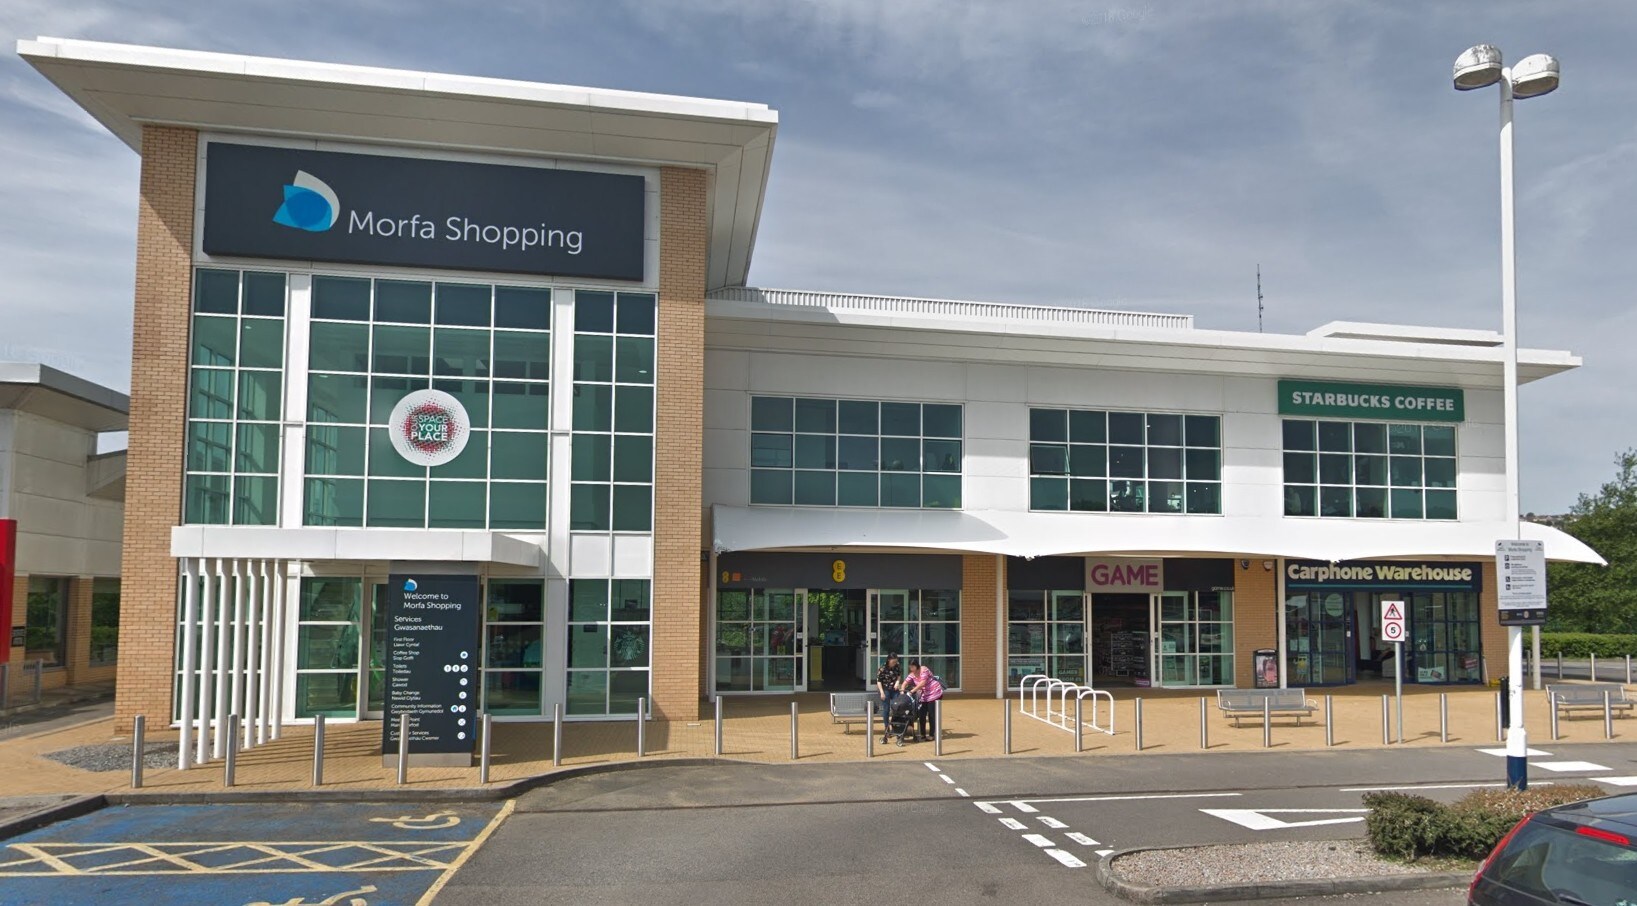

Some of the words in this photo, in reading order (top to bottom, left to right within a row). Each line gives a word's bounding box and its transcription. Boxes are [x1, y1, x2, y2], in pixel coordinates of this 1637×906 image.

[348, 209, 435, 239] Morfa
[445, 216, 583, 255] Shopping
[1292, 391, 1390, 408] STARBUCKS
[1394, 396, 1454, 411] COFFEE
[418, 414, 448, 423] SPACE
[419, 423, 448, 432] YOUR
[411, 431, 448, 441] PLACE
[1091, 564, 1159, 586] GAME
[1287, 564, 1374, 582] Carphone
[1375, 565, 1472, 581] Warehouse
[403, 592, 439, 600] Welcome
[426, 601, 462, 611] Shopping
[394, 615, 422, 623] Services
